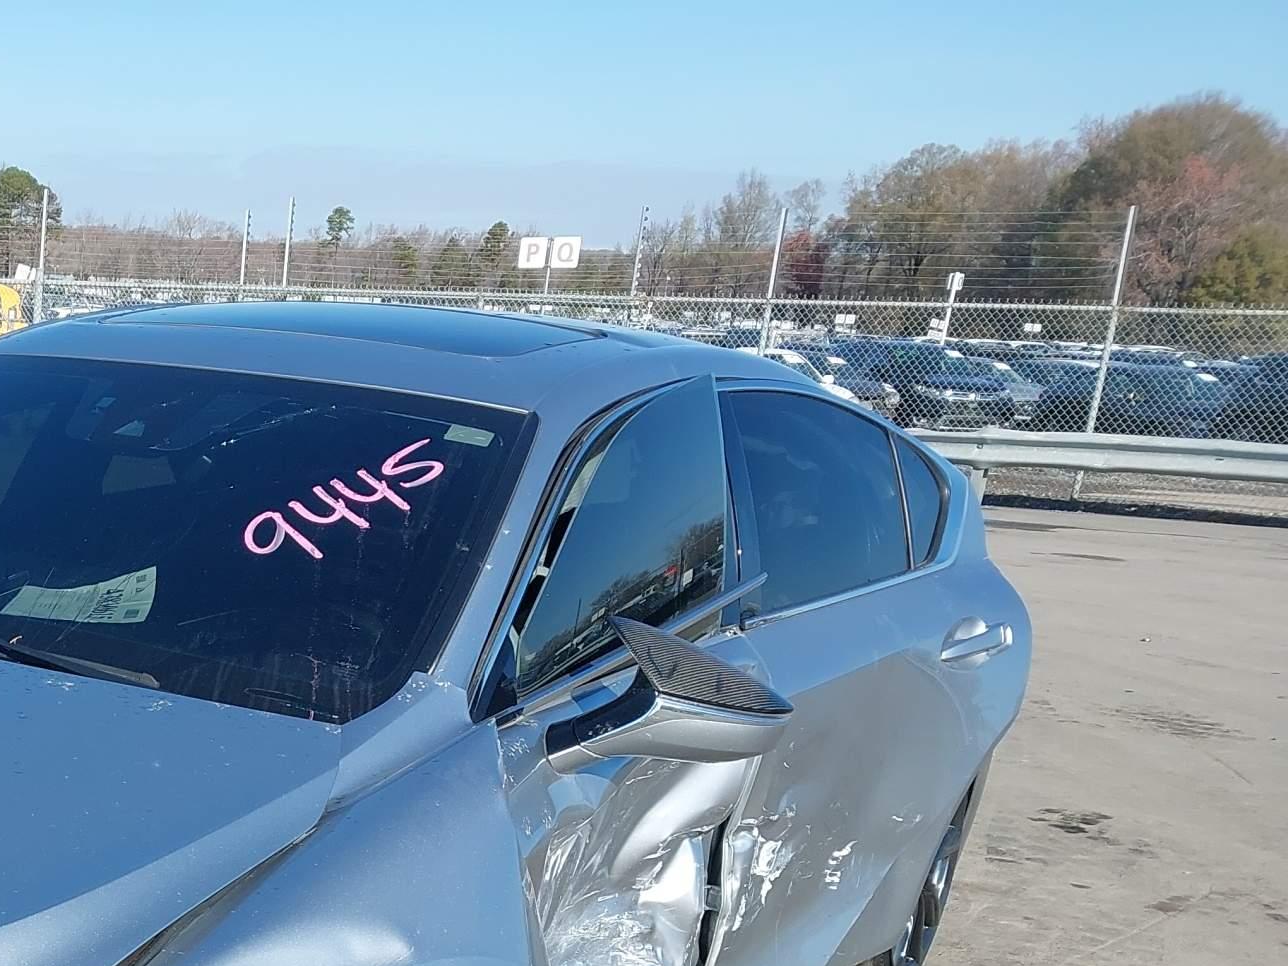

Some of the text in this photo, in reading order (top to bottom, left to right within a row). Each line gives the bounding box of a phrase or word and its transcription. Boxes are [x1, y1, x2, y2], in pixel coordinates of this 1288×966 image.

[526, 243, 540, 263] P
[557, 242, 574, 263] Q
[244, 438, 444, 559] 9445
